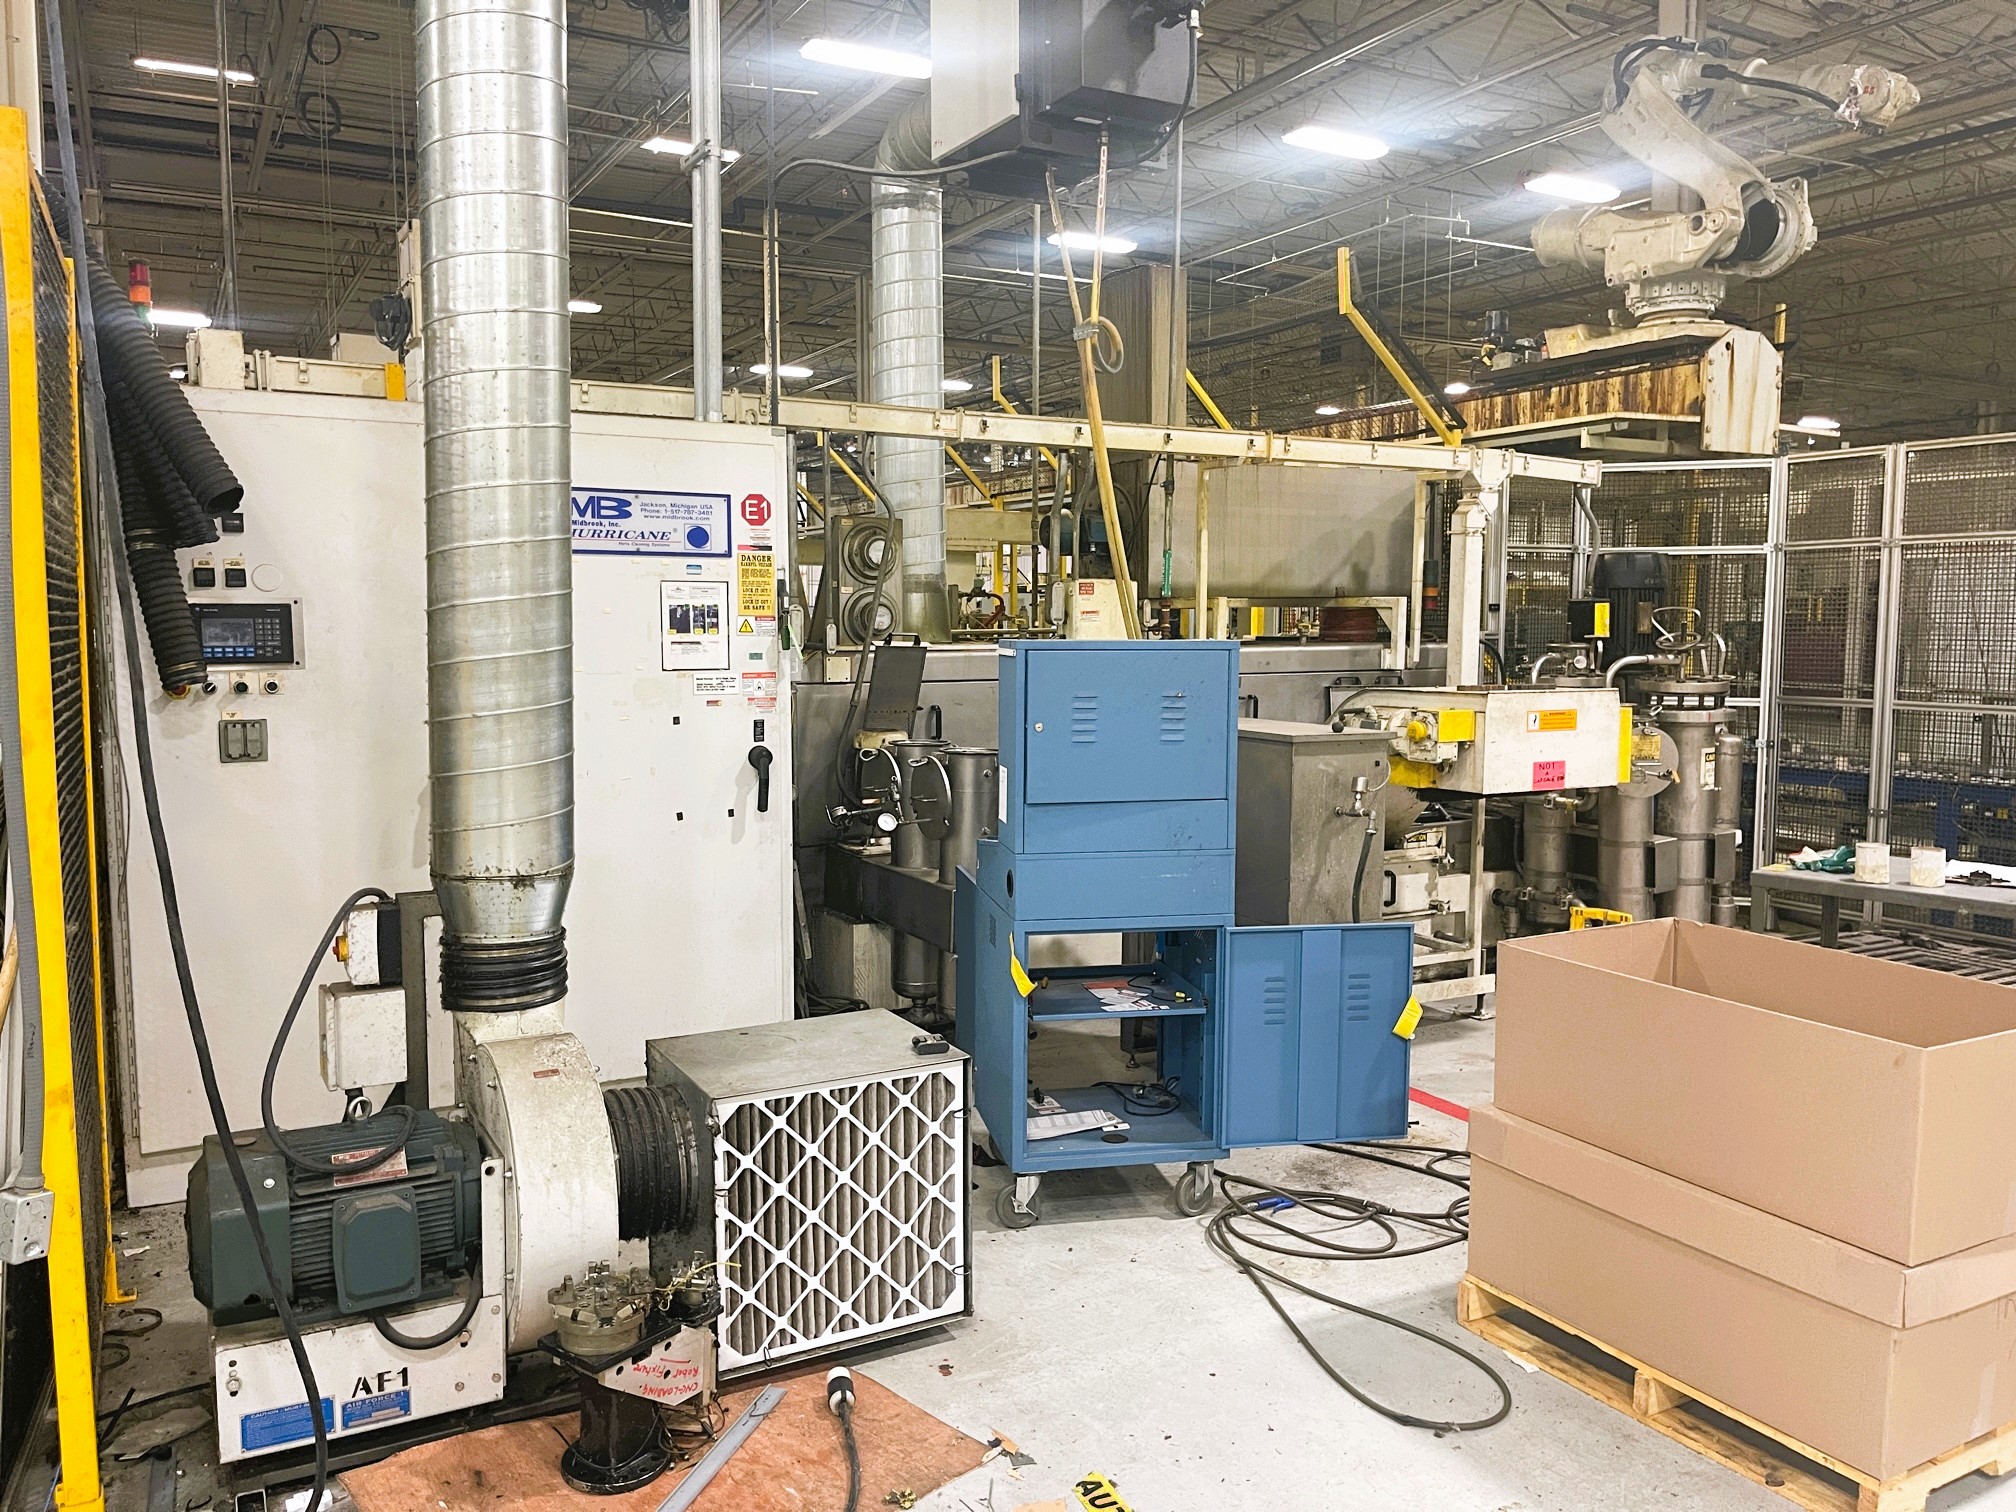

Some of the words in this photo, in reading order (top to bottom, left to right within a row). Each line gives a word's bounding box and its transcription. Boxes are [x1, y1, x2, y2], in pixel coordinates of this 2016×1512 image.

[572, 496, 632, 519] MB
[745, 500, 768, 520] E1
[1538, 762, 1555, 770] NOT
[351, 1366, 409, 1398] AF1
[346, 1400, 362, 1409] AIR
[365, 1394, 398, 1405] FORCE
[250, 1409, 279, 1419] CAUTION
[1076, 1481, 1126, 1512] AU
